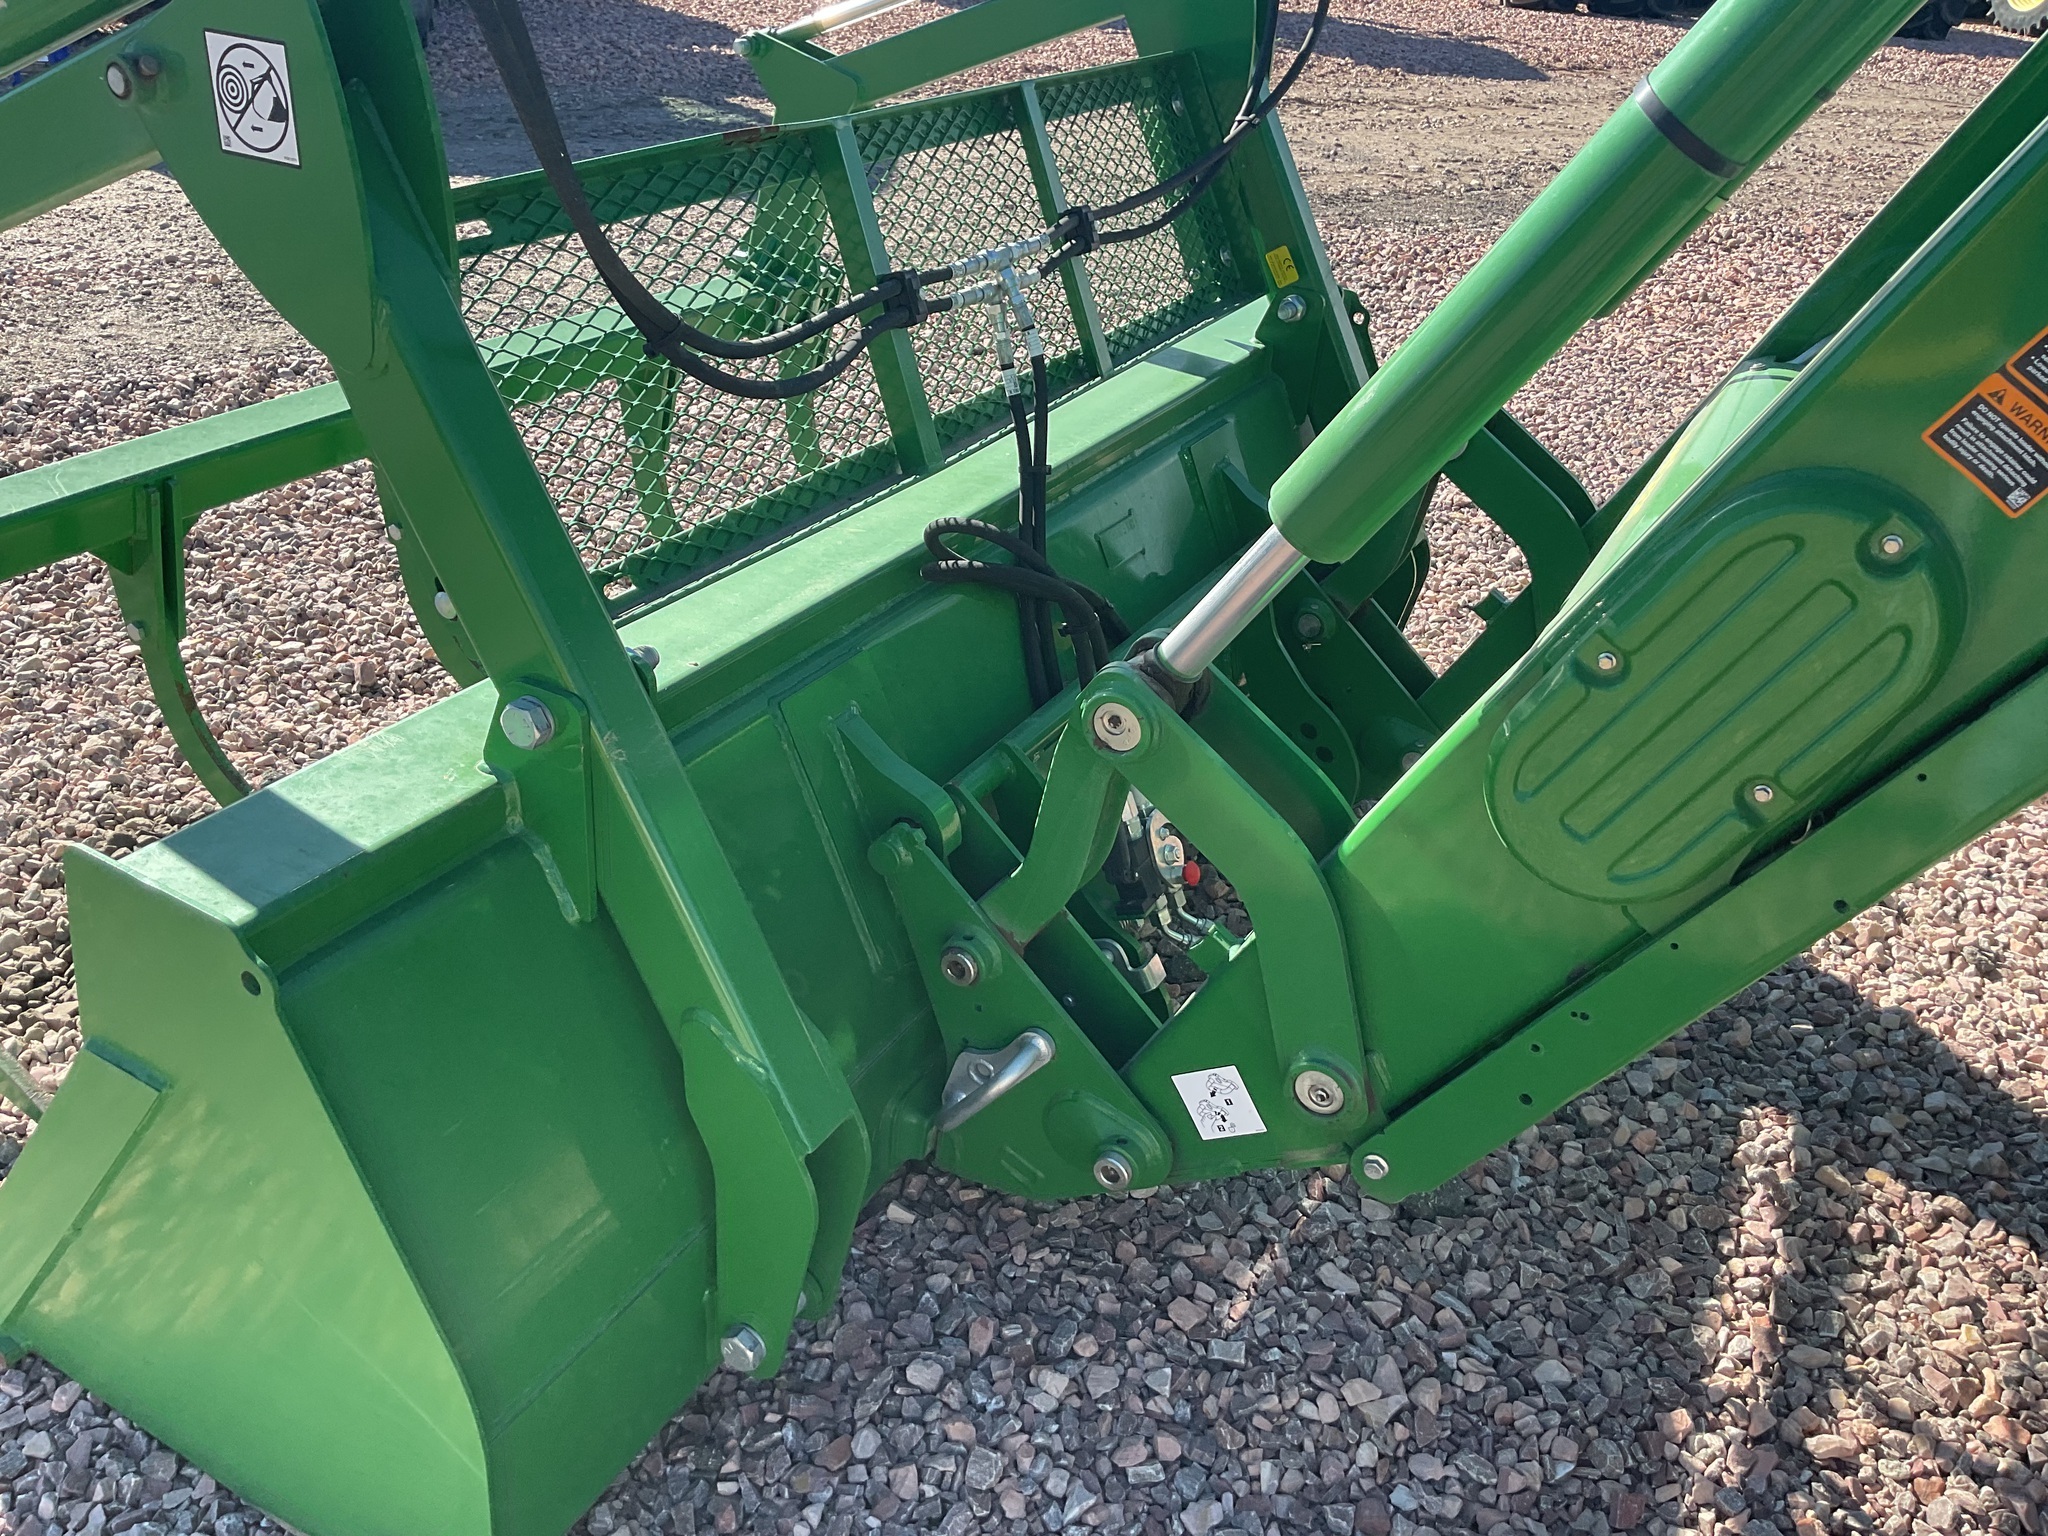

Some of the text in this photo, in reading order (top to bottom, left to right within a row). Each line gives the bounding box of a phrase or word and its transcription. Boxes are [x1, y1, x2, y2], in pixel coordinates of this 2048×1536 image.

[1283, 258, 1294, 272] CE
[1971, 410, 1996, 431] engaging
[1994, 429, 2025, 454] attachment
[1977, 404, 1989, 413] DO
[1986, 411, 2001, 422] NOT
[1998, 422, 2019, 439] operate
[2017, 437, 2035, 453] loader
[2010, 402, 2048, 444] WARN
[1942, 433, 1960, 448] bodily
[1957, 446, 1974, 460] injury
[1948, 428, 2015, 486] from loader causing serious
[1954, 424, 1971, 437] result
[1974, 440, 2005, 465] attachment
[2002, 464, 2027, 487] detaching
[1961, 417, 1980, 434] Failure
[1984, 438, 2005, 454] engage
[2021, 470, 2038, 484] could
